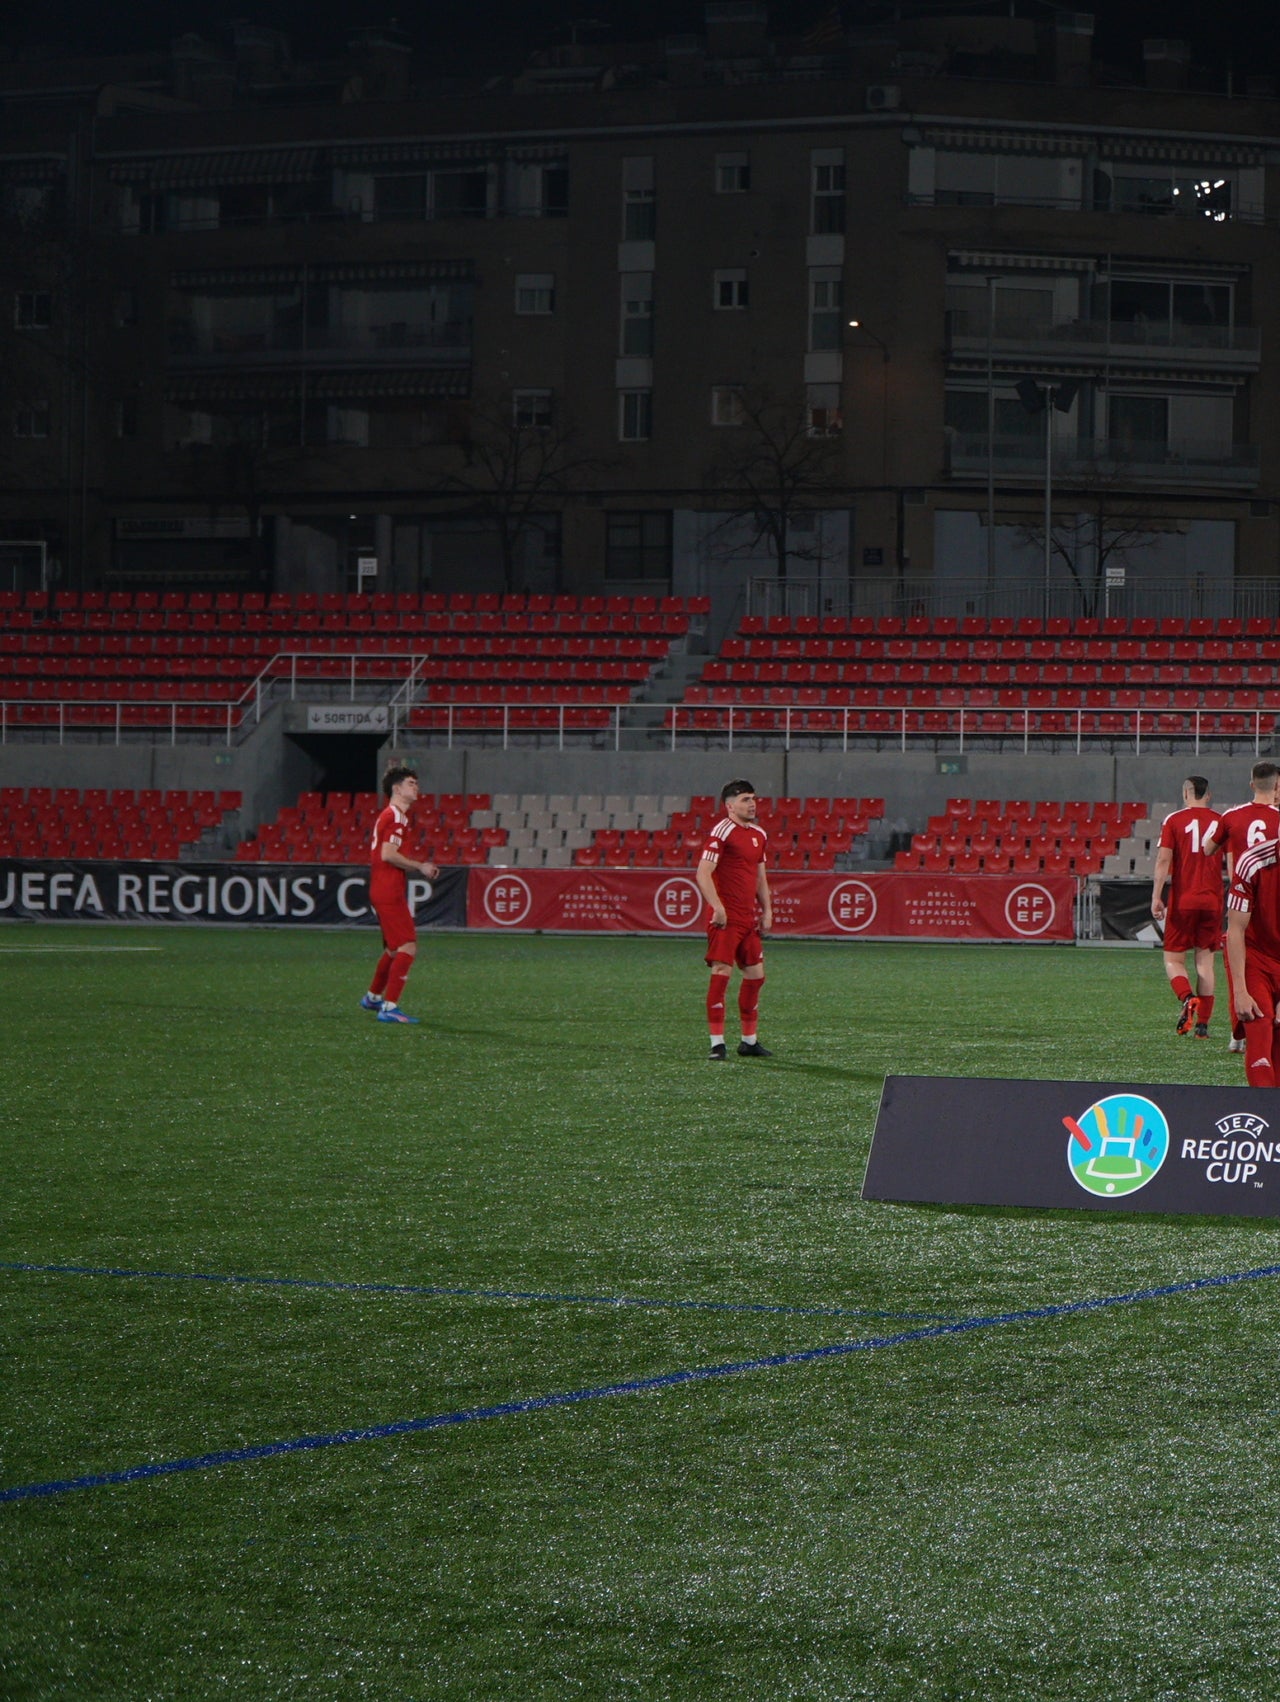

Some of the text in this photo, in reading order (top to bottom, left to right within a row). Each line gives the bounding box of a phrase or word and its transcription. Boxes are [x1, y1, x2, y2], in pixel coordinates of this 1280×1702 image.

[324, 713, 371, 724] SORTIDA
[1247, 819, 1267, 848] 6
[0, 872, 433, 919] UEFA REGIONS' CP
[1217, 1116, 1264, 1137] UEFA
[1206, 1161, 1258, 1184] CUP
